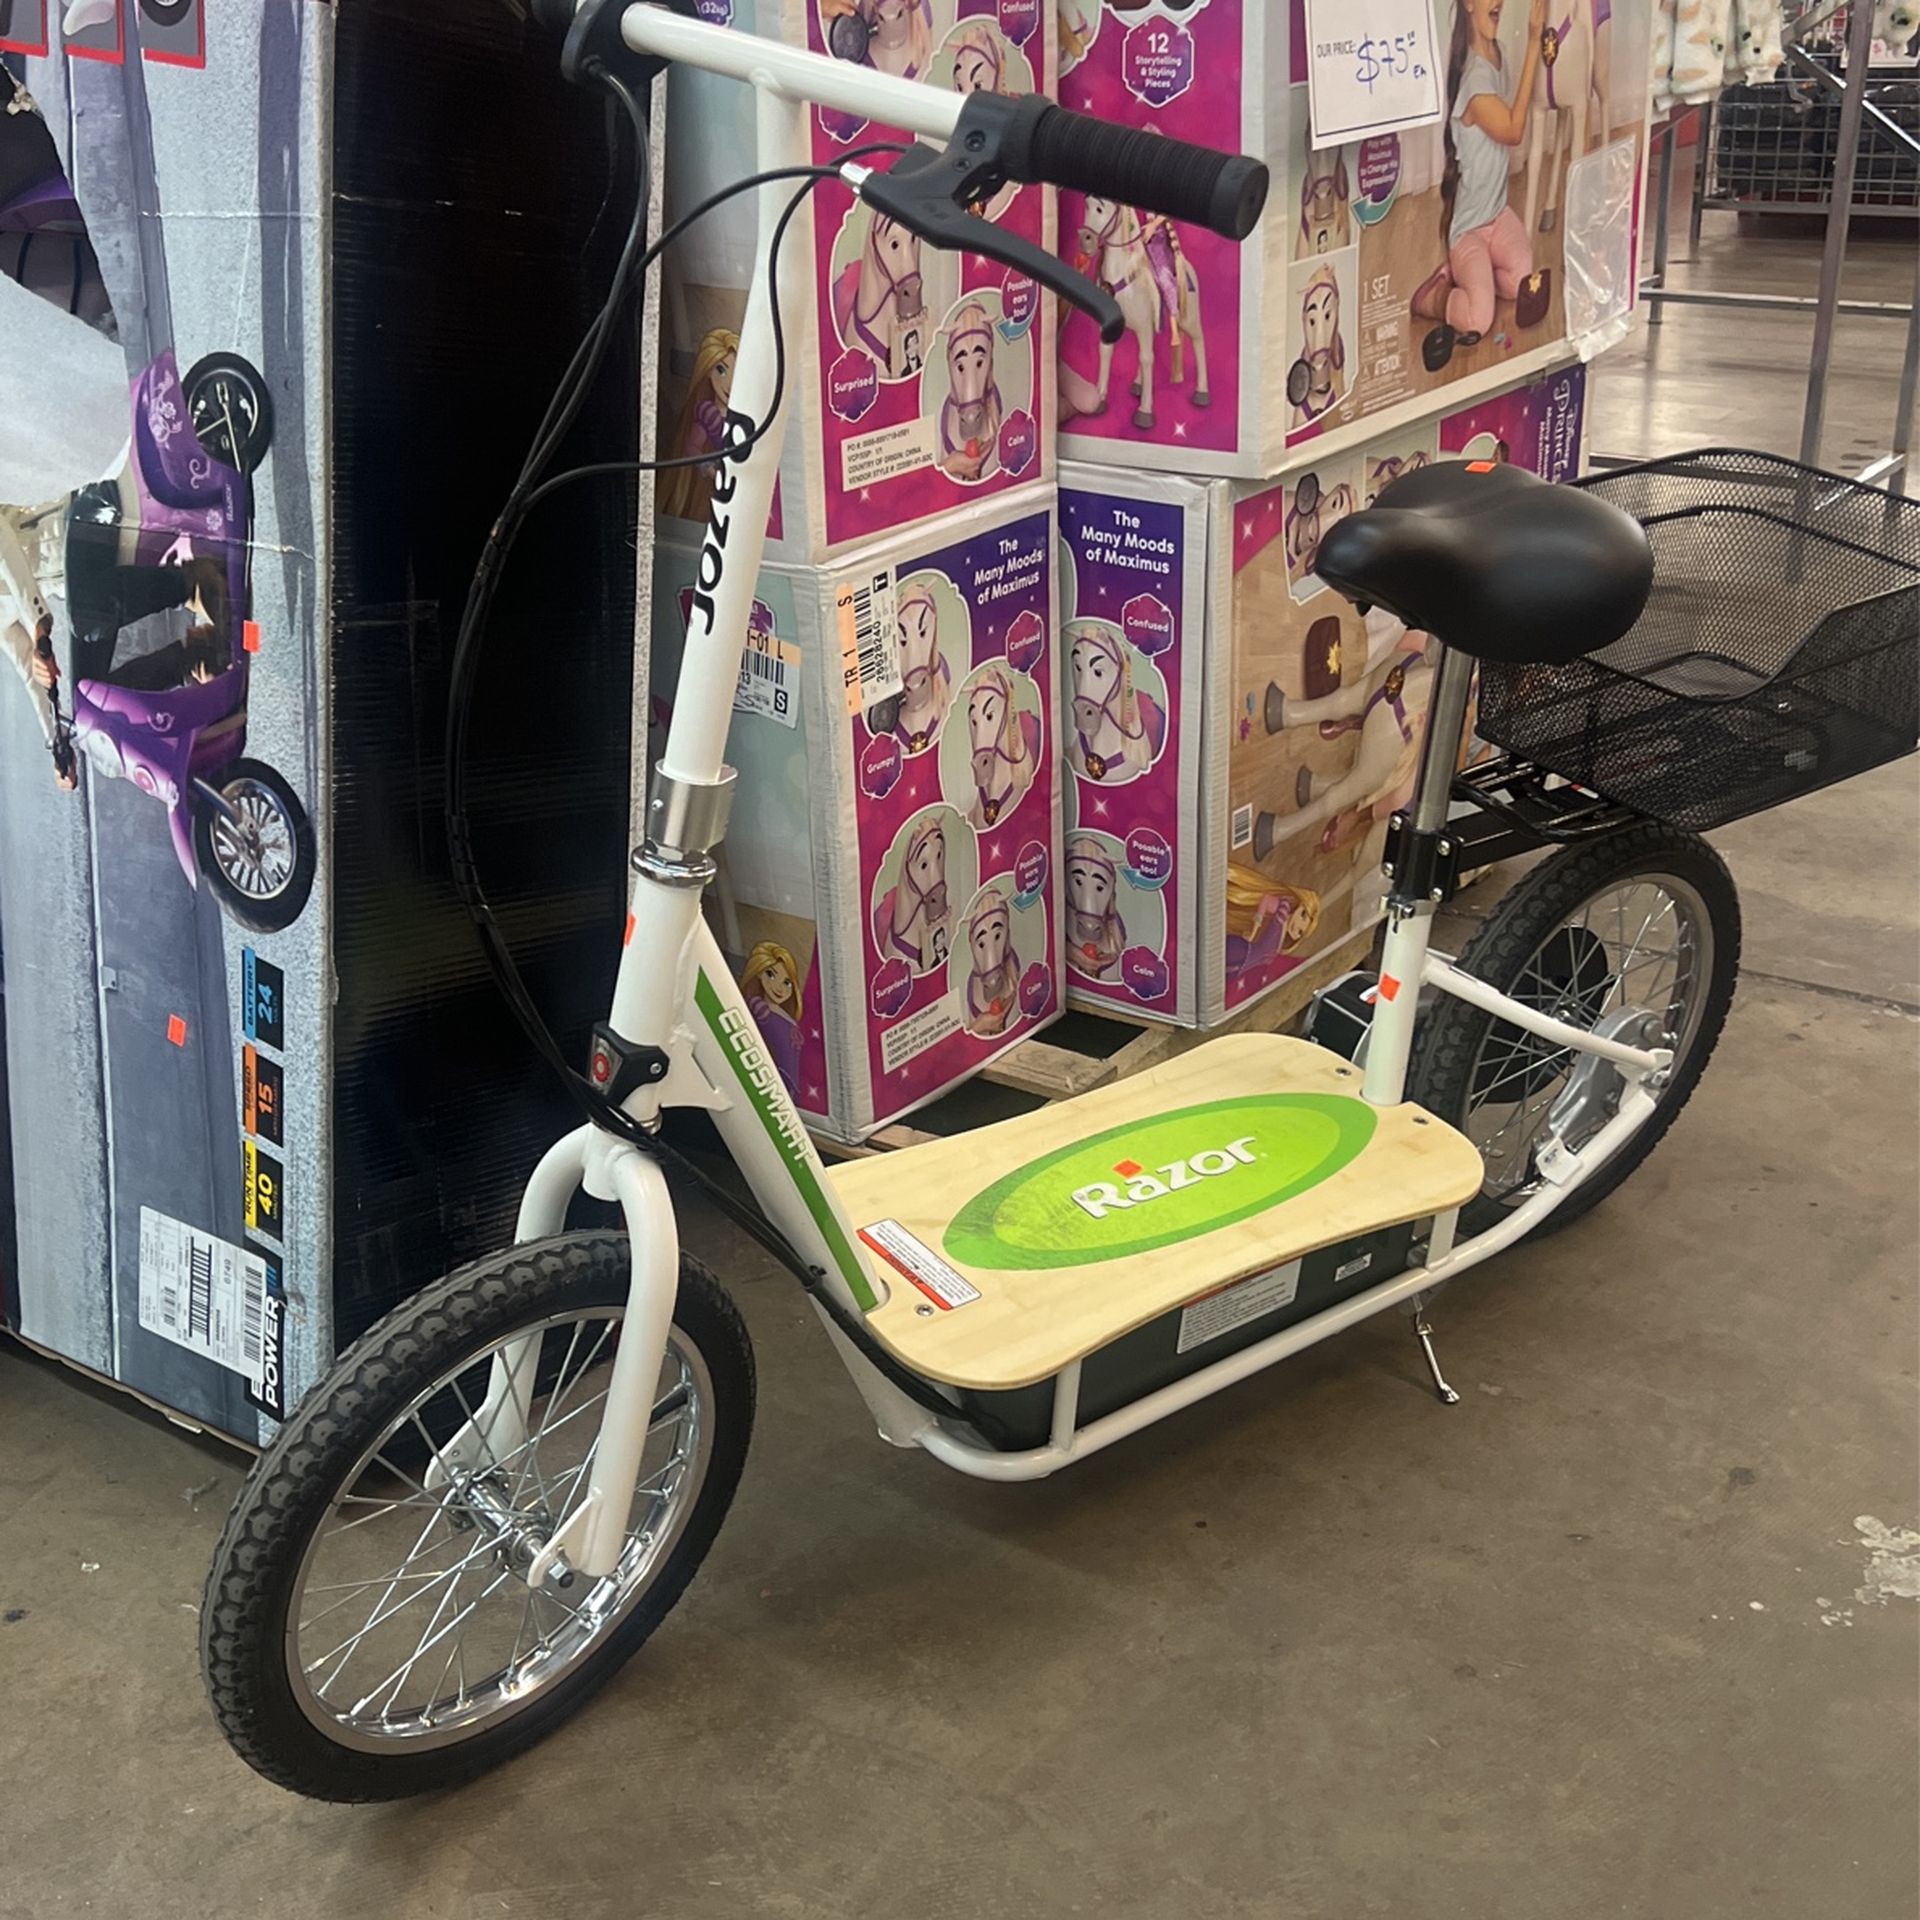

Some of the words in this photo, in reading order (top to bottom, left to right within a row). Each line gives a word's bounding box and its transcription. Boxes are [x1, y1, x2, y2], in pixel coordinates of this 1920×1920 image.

[1147, 32, 1169, 53] 12
[1316, 43, 1331, 58] OUR
[1135, 55, 1182, 67] Storytelling
[1148, 67, 1176, 78] Styling
[1145, 79, 1171, 88] Pieces
[1371, 274, 1391, 300] SET
[834, 373, 874, 394] Surprised
[1007, 436, 1026, 448] Calm
[1112, 510, 1140, 529] The
[999, 537, 1018, 556] The
[1081, 525, 1122, 549] Many
[1125, 534, 1175, 555] Moods
[974, 560, 1005, 587] Many
[1006, 547, 1043, 574] Moods
[1085, 547, 1102, 562] of
[1104, 551, 1170, 575] Maximus
[977, 585, 991, 606] of
[991, 572, 1040, 599] Maximus
[837, 595, 853, 608] S
[1126, 615, 1169, 633] Confused
[1009, 632, 1041, 651] Confused
[844, 665, 859, 688] TR
[776, 692, 787, 711] S
[866, 756, 896, 778] Grumpy
[1132, 839, 1166, 855] Posable
[1139, 855, 1158, 866] ears
[1133, 964, 1155, 978] Calm
[874, 976, 909, 1000] Surprised
[258, 983, 273, 1024] 24
[718, 1006, 815, 1162] ECOSMART
[258, 1082, 273, 1113] 15
[1071, 1136, 1257, 1220] Razor
[258, 1173, 273, 1215] 40
[265, 1295, 279, 1409] POWER
